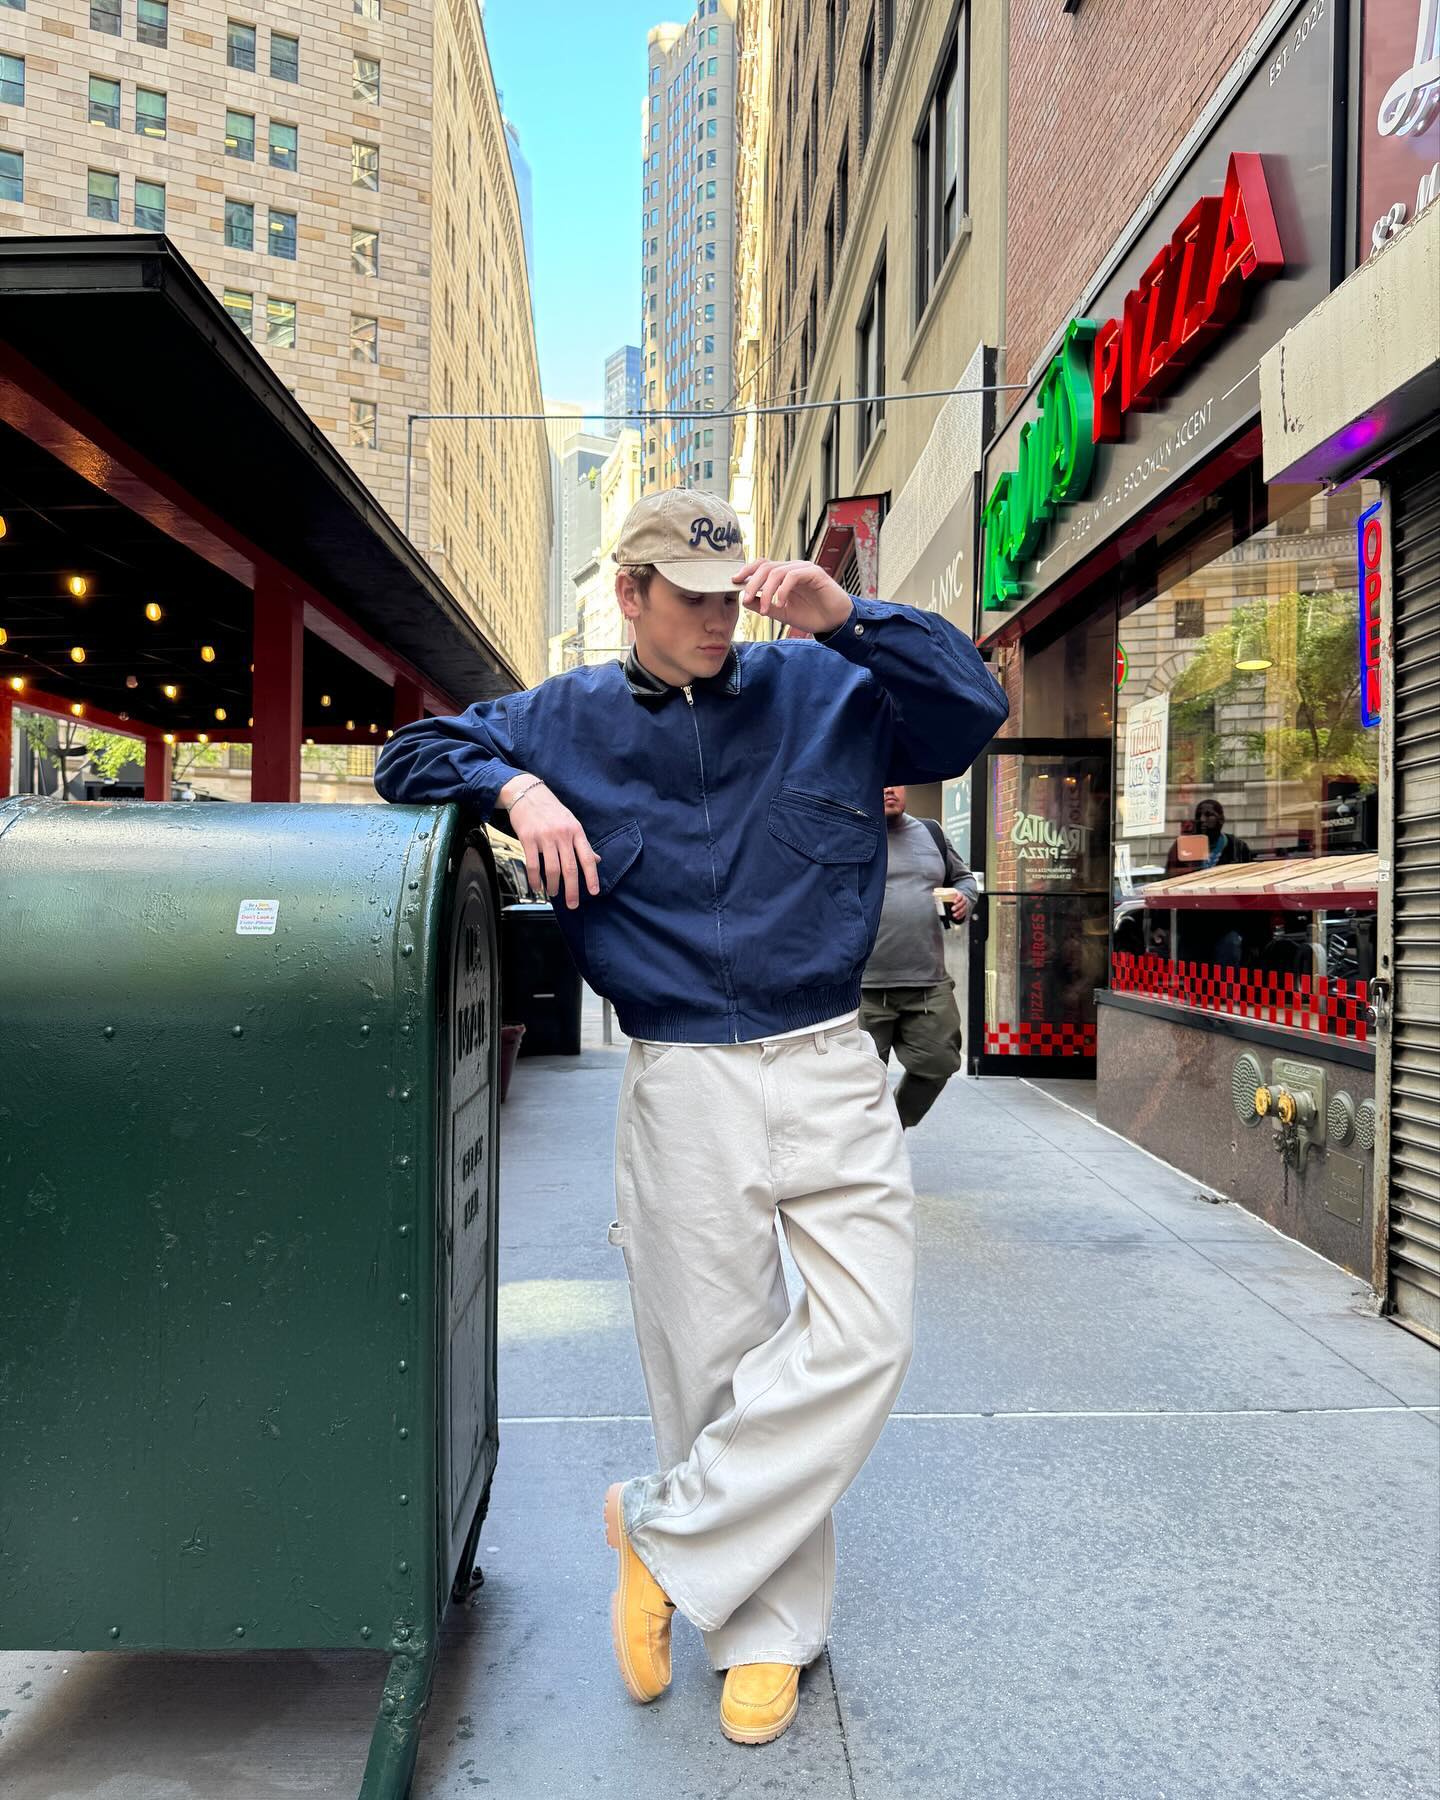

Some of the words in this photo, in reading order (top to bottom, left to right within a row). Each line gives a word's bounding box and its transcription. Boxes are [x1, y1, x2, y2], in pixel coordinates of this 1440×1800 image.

[1269, 45, 1290, 87] EST.
[1294, 0, 1325, 53] 2022
[1093, 152, 1285, 443] PIZZA
[1124, 438, 1171, 498] BROOKLYN
[1176, 398, 1213, 448] ACCENT
[940, 550, 963, 614] NYC
[1363, 519, 1382, 713] OPEN
[1130, 720, 1161, 757] ITALIAN
[1031, 913, 1046, 969] HEROES
[458, 999, 486, 1060] MAIL
[1030, 980, 1044, 1020] PIZZA
